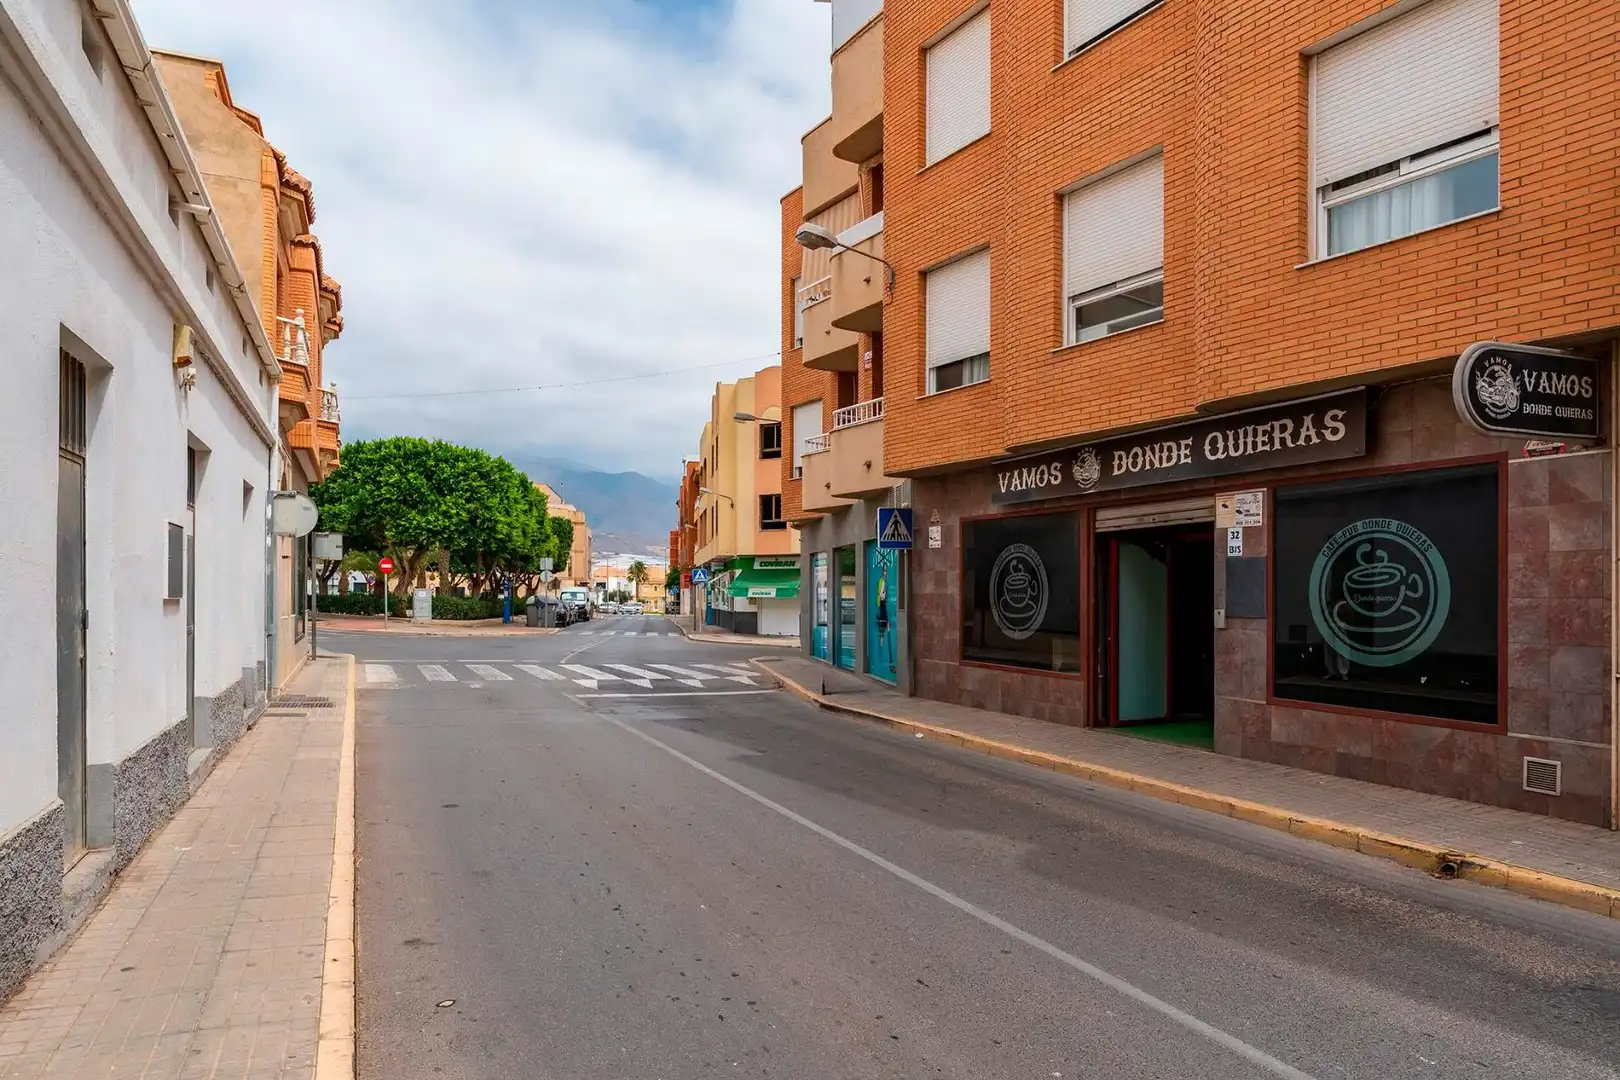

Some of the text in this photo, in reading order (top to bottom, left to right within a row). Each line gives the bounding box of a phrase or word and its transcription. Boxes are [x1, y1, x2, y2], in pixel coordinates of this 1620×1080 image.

[1522, 369, 1593, 398] VAMOS
[1522, 403, 1553, 416] DONDE
[1555, 407, 1593, 420] QUIERAS
[998, 409, 1348, 493] VAMOS DONDE QUIERAS
[1230, 531, 1240, 540] 32
[1361, 519, 1393, 531] DONDE
[1396, 522, 1433, 553] QUIERAS
[1229, 545, 1241, 554] BIS
